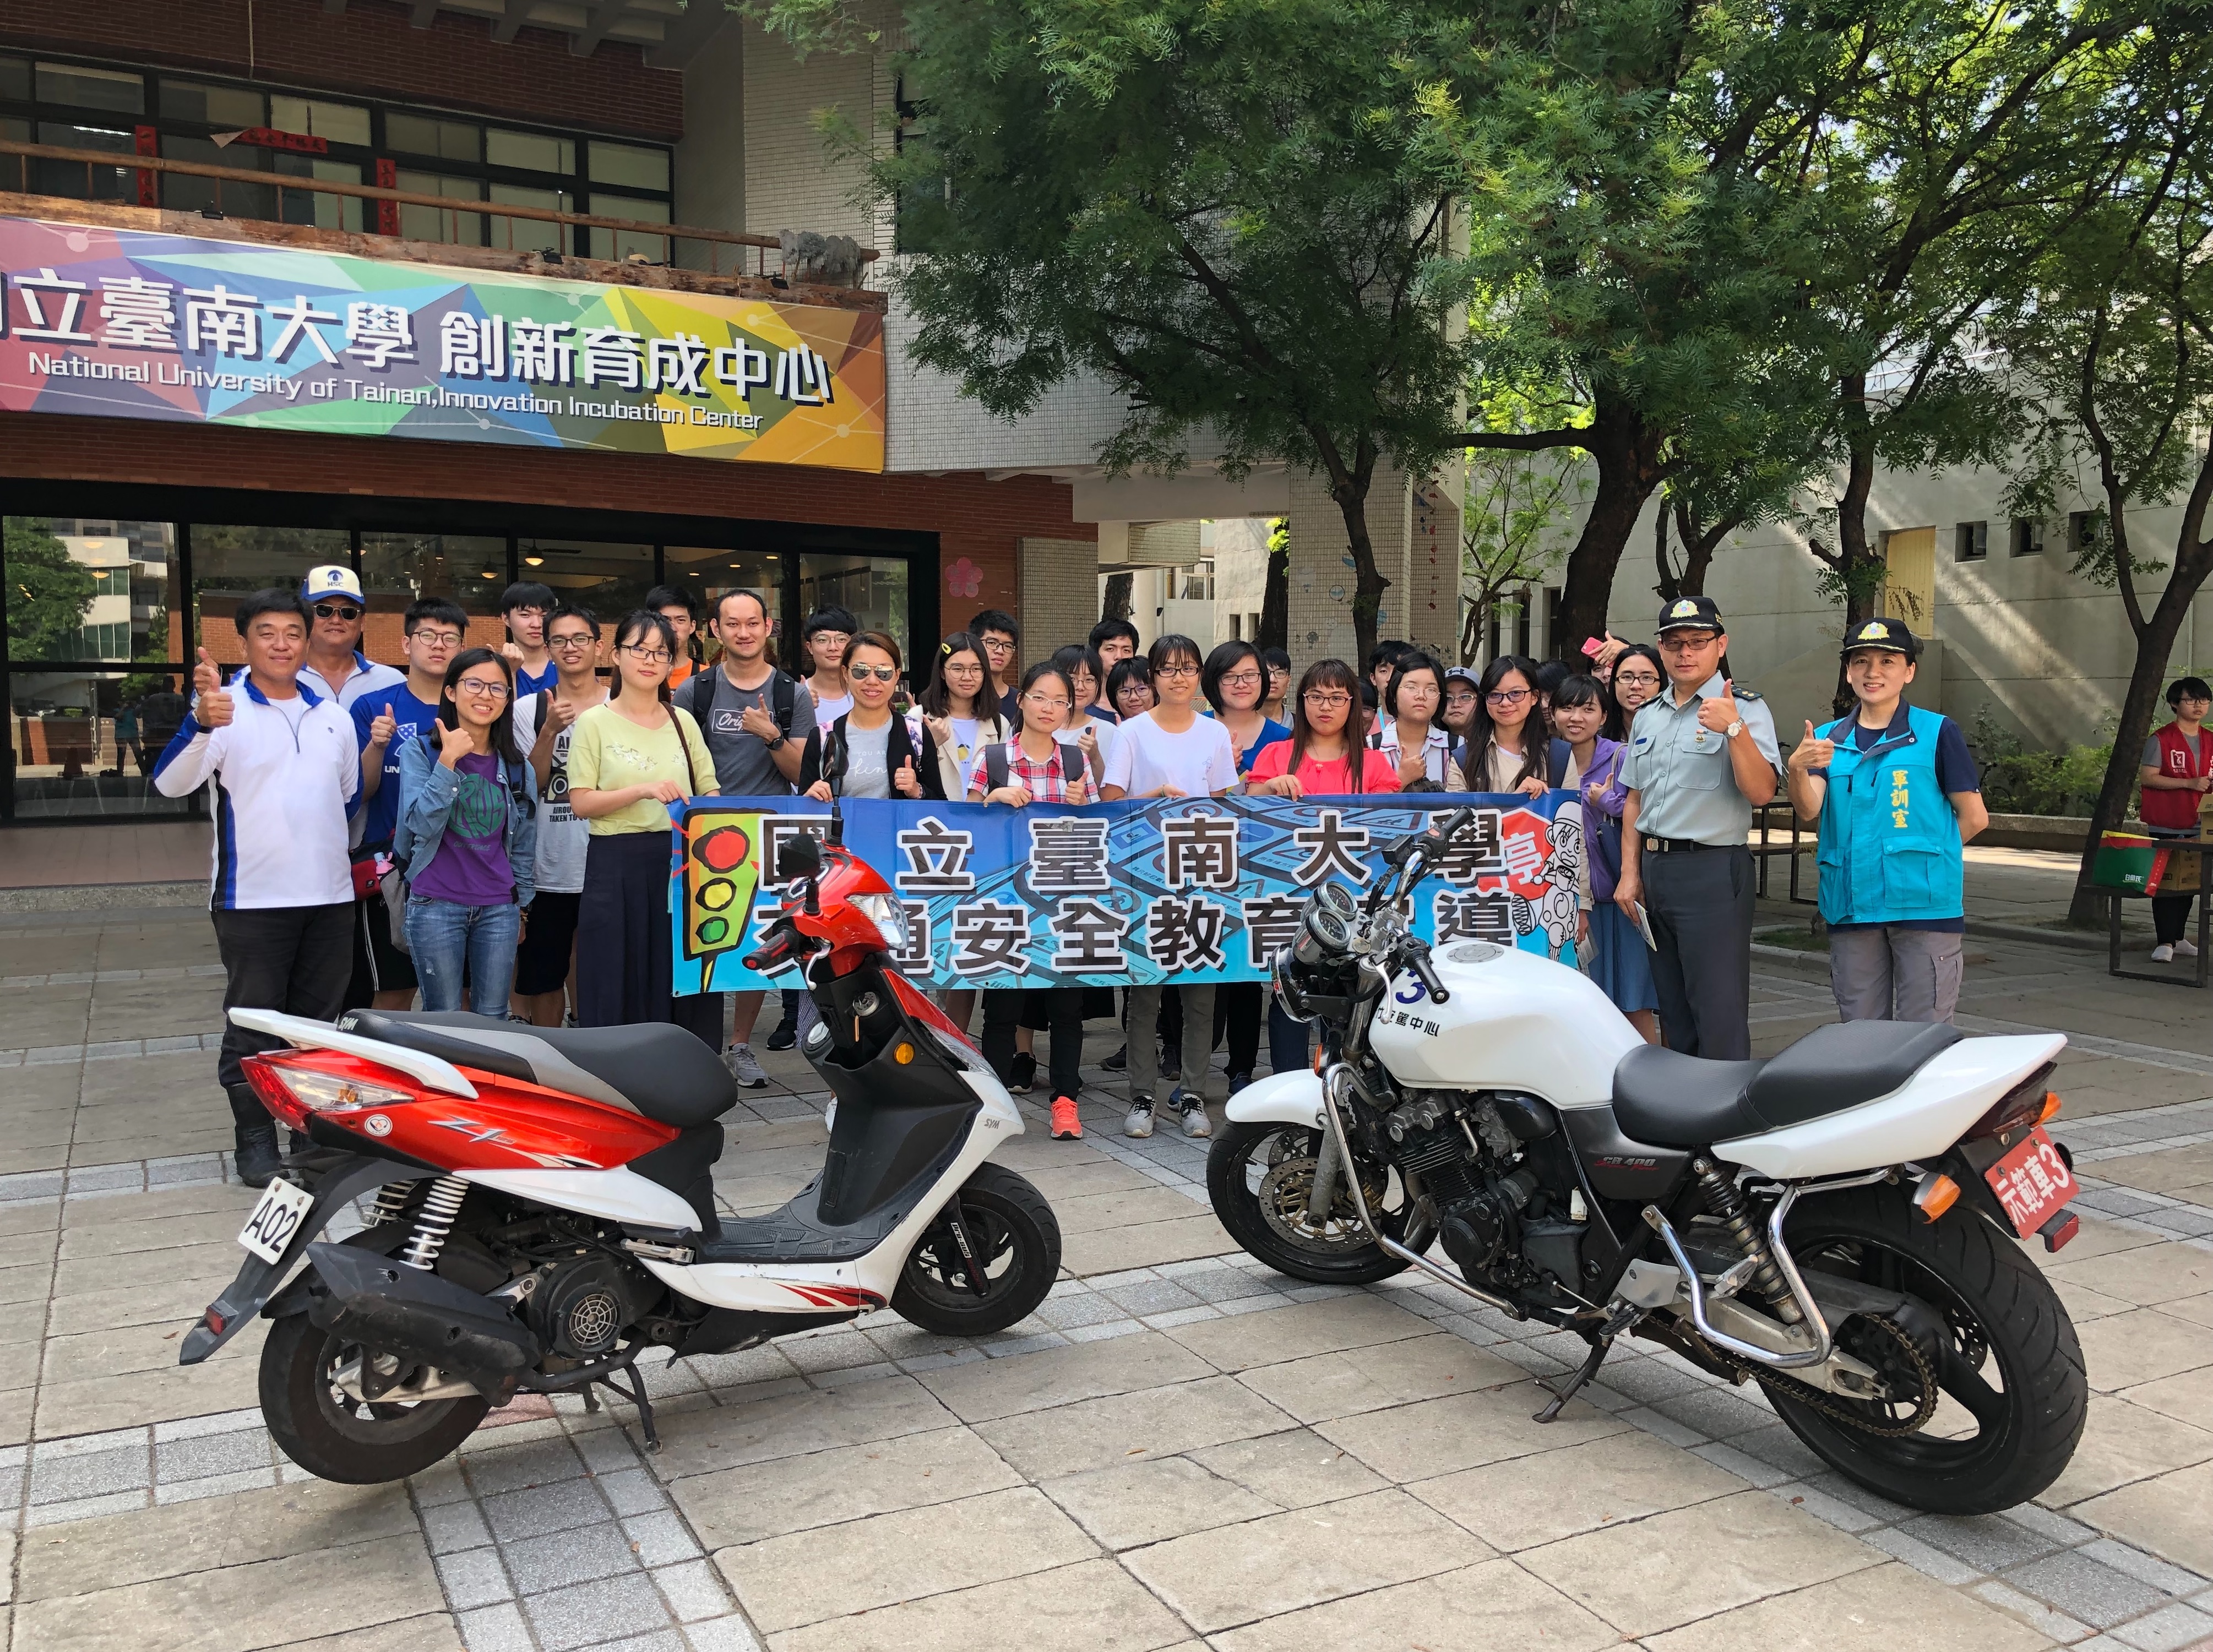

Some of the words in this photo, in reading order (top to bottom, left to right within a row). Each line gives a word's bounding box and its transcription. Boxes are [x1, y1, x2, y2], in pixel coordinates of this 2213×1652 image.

[0, 268, 417, 369] 立臺南大學
[439, 310, 833, 403] 創新育成中心
[29, 351, 150, 382] National
[158, 363, 303, 400] University
[310, 378, 338, 398] of
[569, 400, 685, 425] Incubation
[691, 406, 764, 430] Center
[849, 758, 888, 777] kin
[1890, 770, 1910, 828] 軍訓室
[753, 888, 1515, 975] 安全教育導
[338, 1017, 358, 1031] SYM
[984, 1118, 1000, 1129] SYM
[1603, 1157, 1623, 1165] CB
[1624, 1158, 1656, 1166] 400
[244, 1197, 299, 1254] A02
